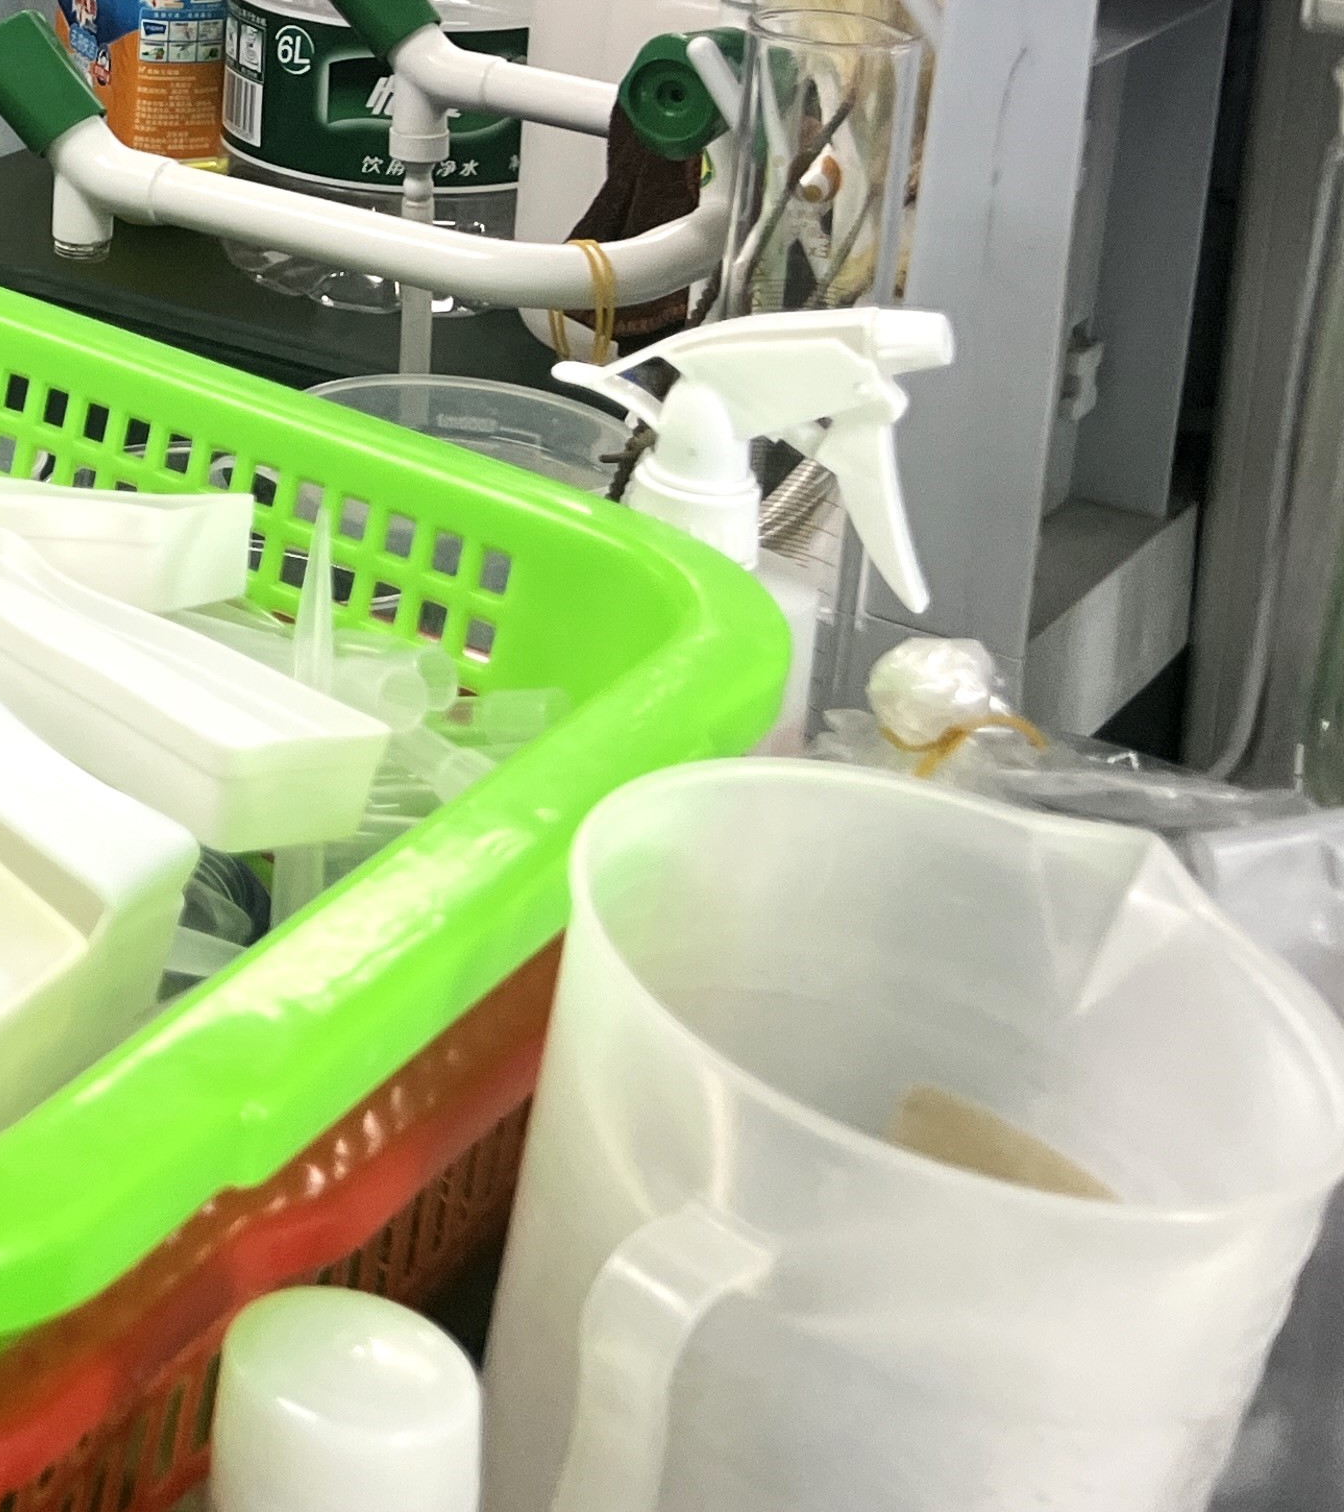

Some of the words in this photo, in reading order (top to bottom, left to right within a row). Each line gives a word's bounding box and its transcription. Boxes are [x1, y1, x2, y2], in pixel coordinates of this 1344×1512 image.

[277, 35, 311, 65] 6L
[361, 155, 480, 177] 饮用净水
